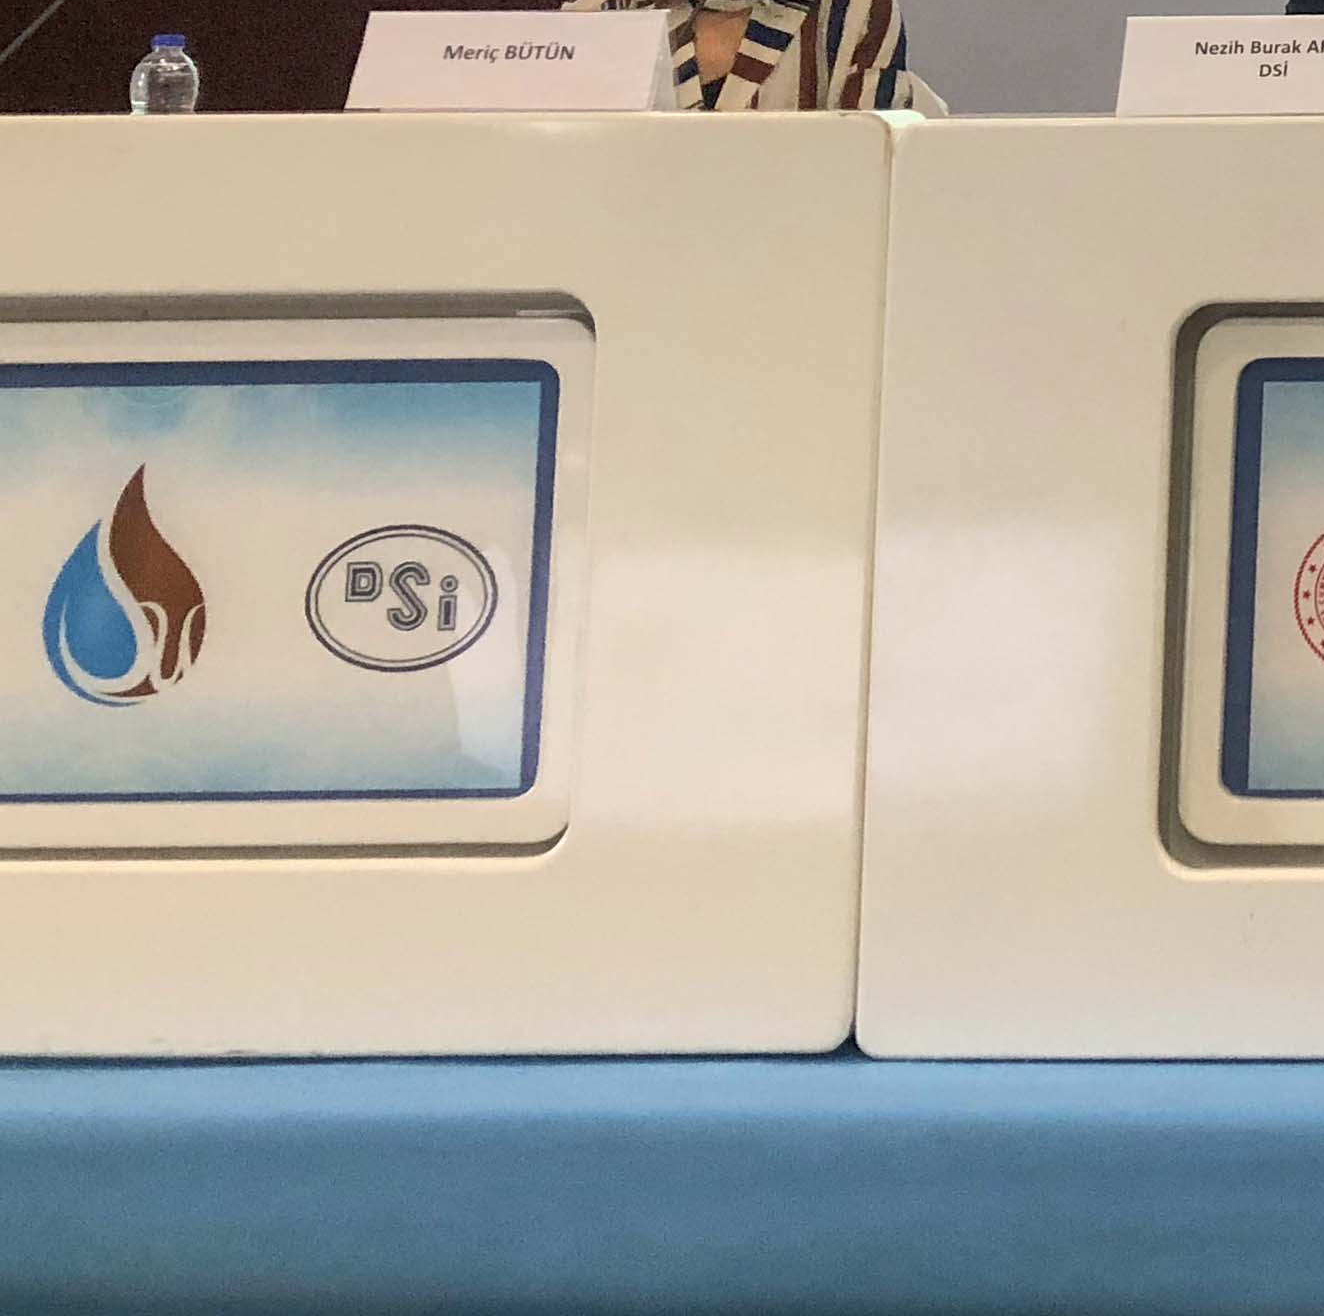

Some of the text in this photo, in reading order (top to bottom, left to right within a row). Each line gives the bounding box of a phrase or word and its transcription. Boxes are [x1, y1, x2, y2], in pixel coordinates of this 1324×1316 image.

[442, 41, 575, 63] Meriç BÜTÜN
[1195, 40, 1244, 55] Nezih
[1251, 40, 1301, 55] Burak
[1259, 61, 1288, 77] DSİ
